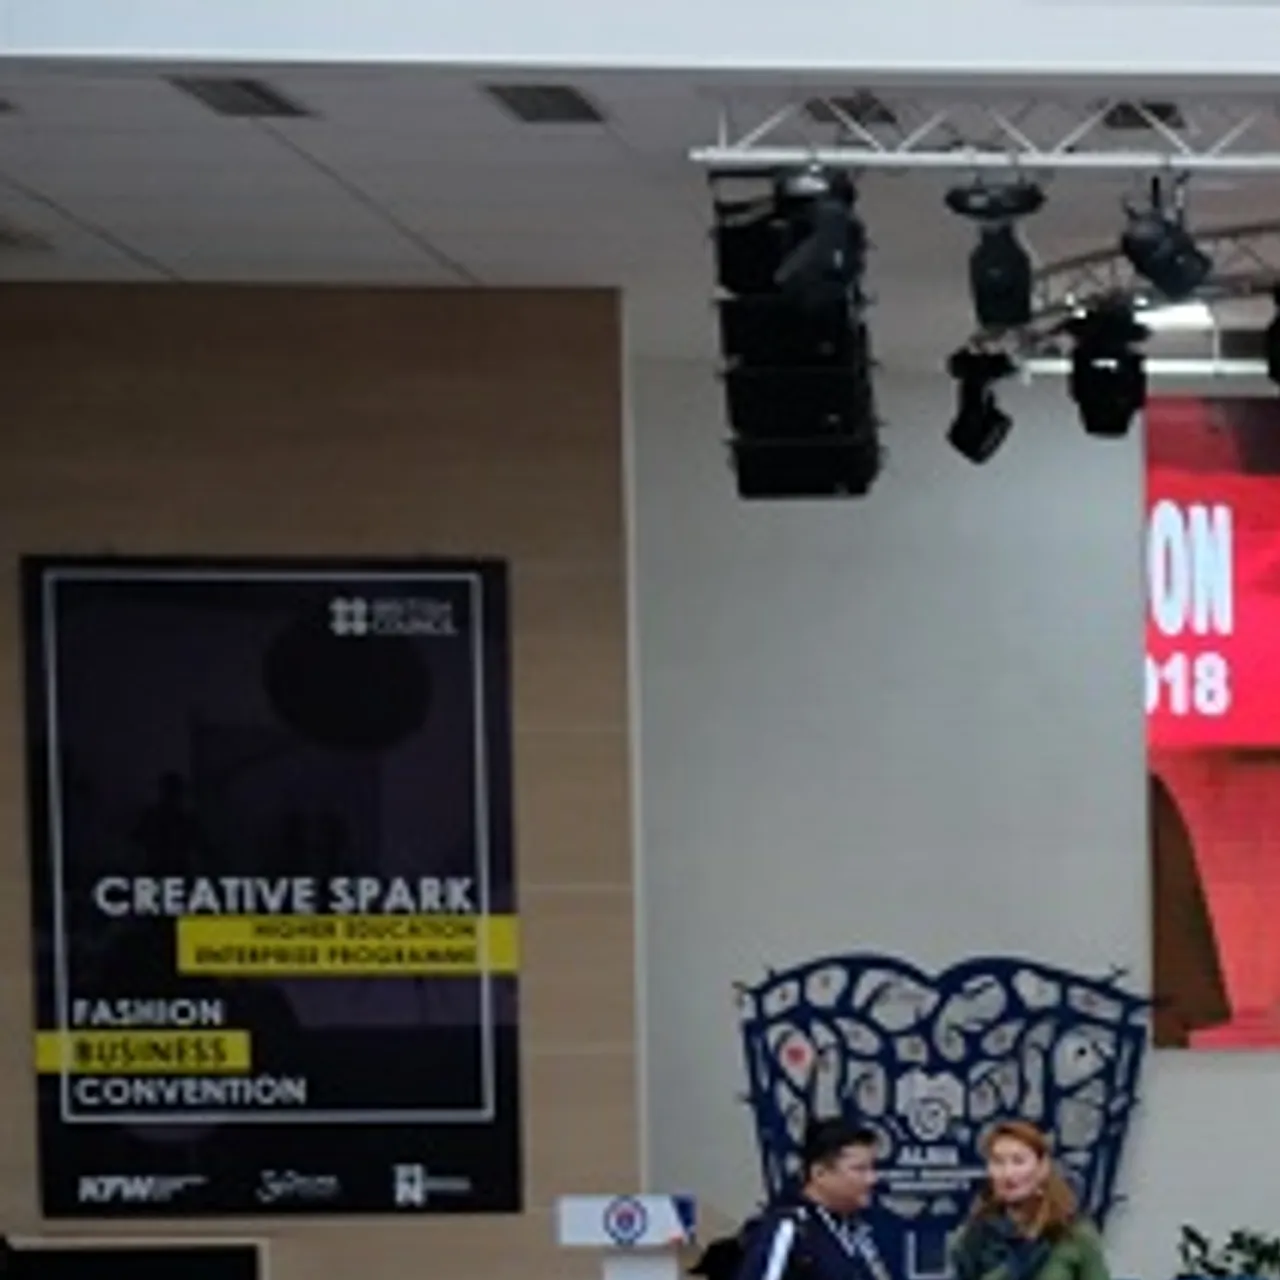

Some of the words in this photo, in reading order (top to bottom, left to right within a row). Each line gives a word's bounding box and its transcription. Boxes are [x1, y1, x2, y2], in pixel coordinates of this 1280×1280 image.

[1151, 499, 1232, 635] ON
[94, 876, 314, 915] CREATIVE
[329, 877, 473, 914] SPARK
[254, 919, 336, 939] HIGHER
[346, 919, 476, 939] EDUCATION
[195, 945, 319, 964] ENTERPRISE
[329, 945, 477, 964] PROGRAMME
[73, 999, 223, 1026] FASHION
[73, 1036, 228, 1065] BUSINESS
[74, 1076, 307, 1105] CONVENTION
